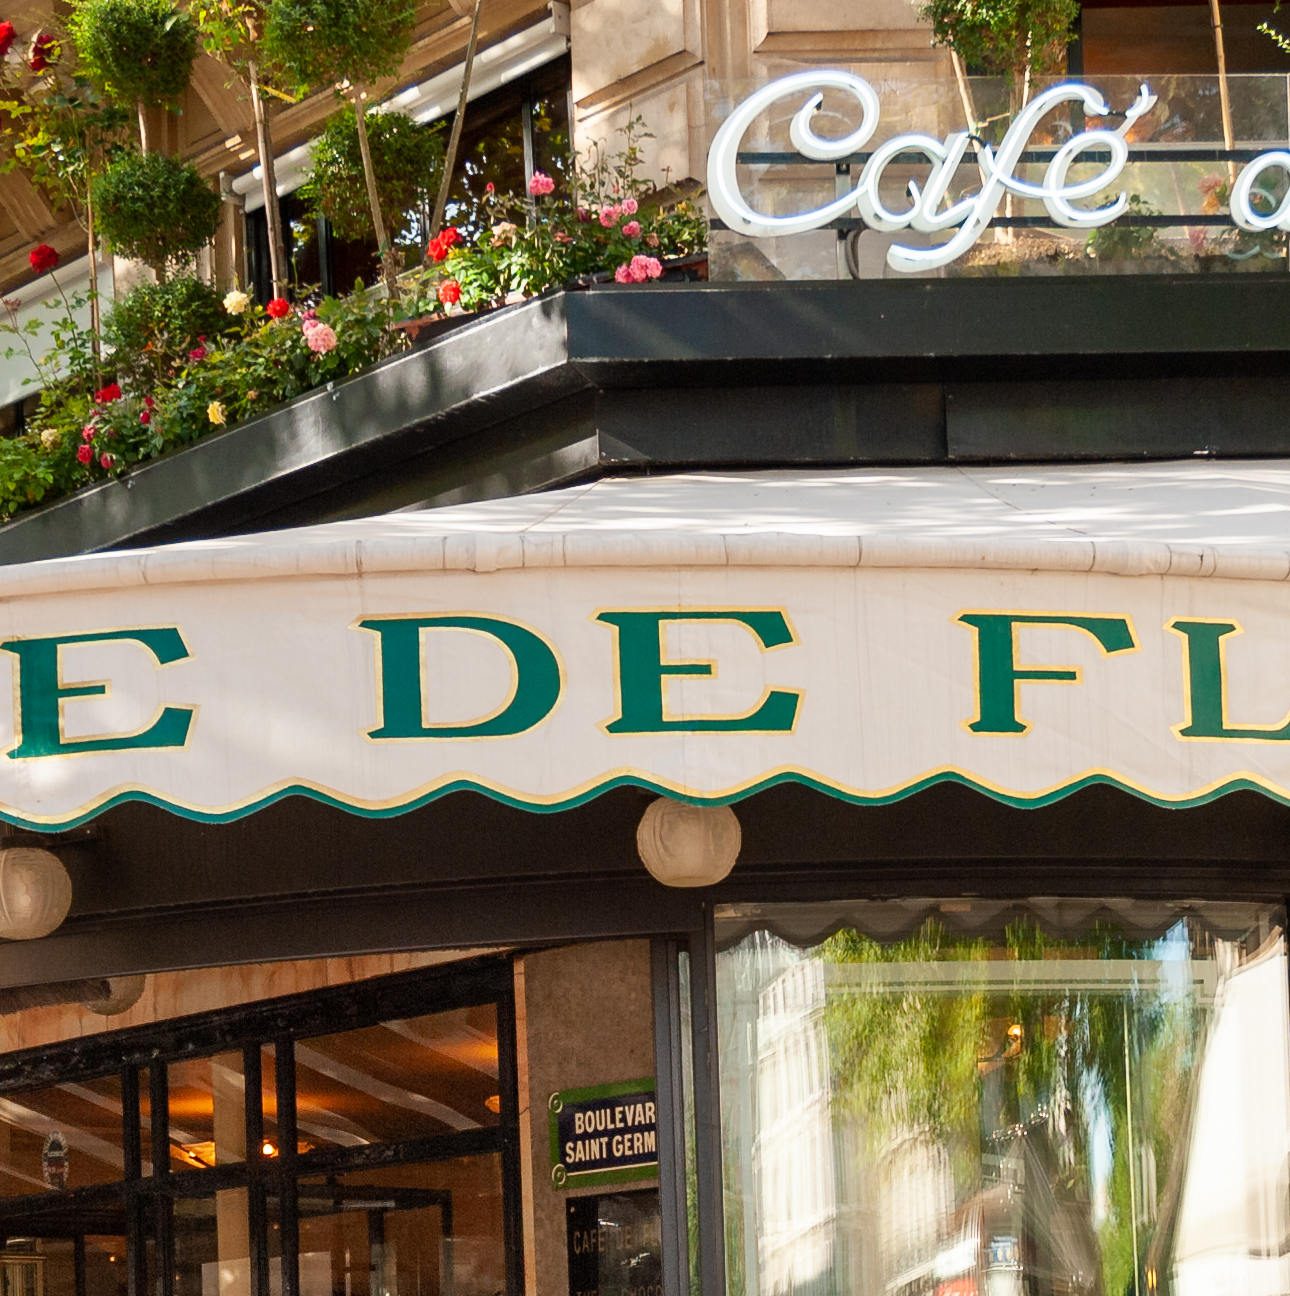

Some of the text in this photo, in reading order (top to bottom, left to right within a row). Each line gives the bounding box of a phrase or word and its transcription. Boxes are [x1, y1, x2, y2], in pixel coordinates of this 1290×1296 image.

[707, 68, 1157, 272] Café
[349, 606, 806, 743] DE
[565, 1131, 656, 1163] SAINT GERM
[574, 1102, 656, 1134] BOULEVAR
